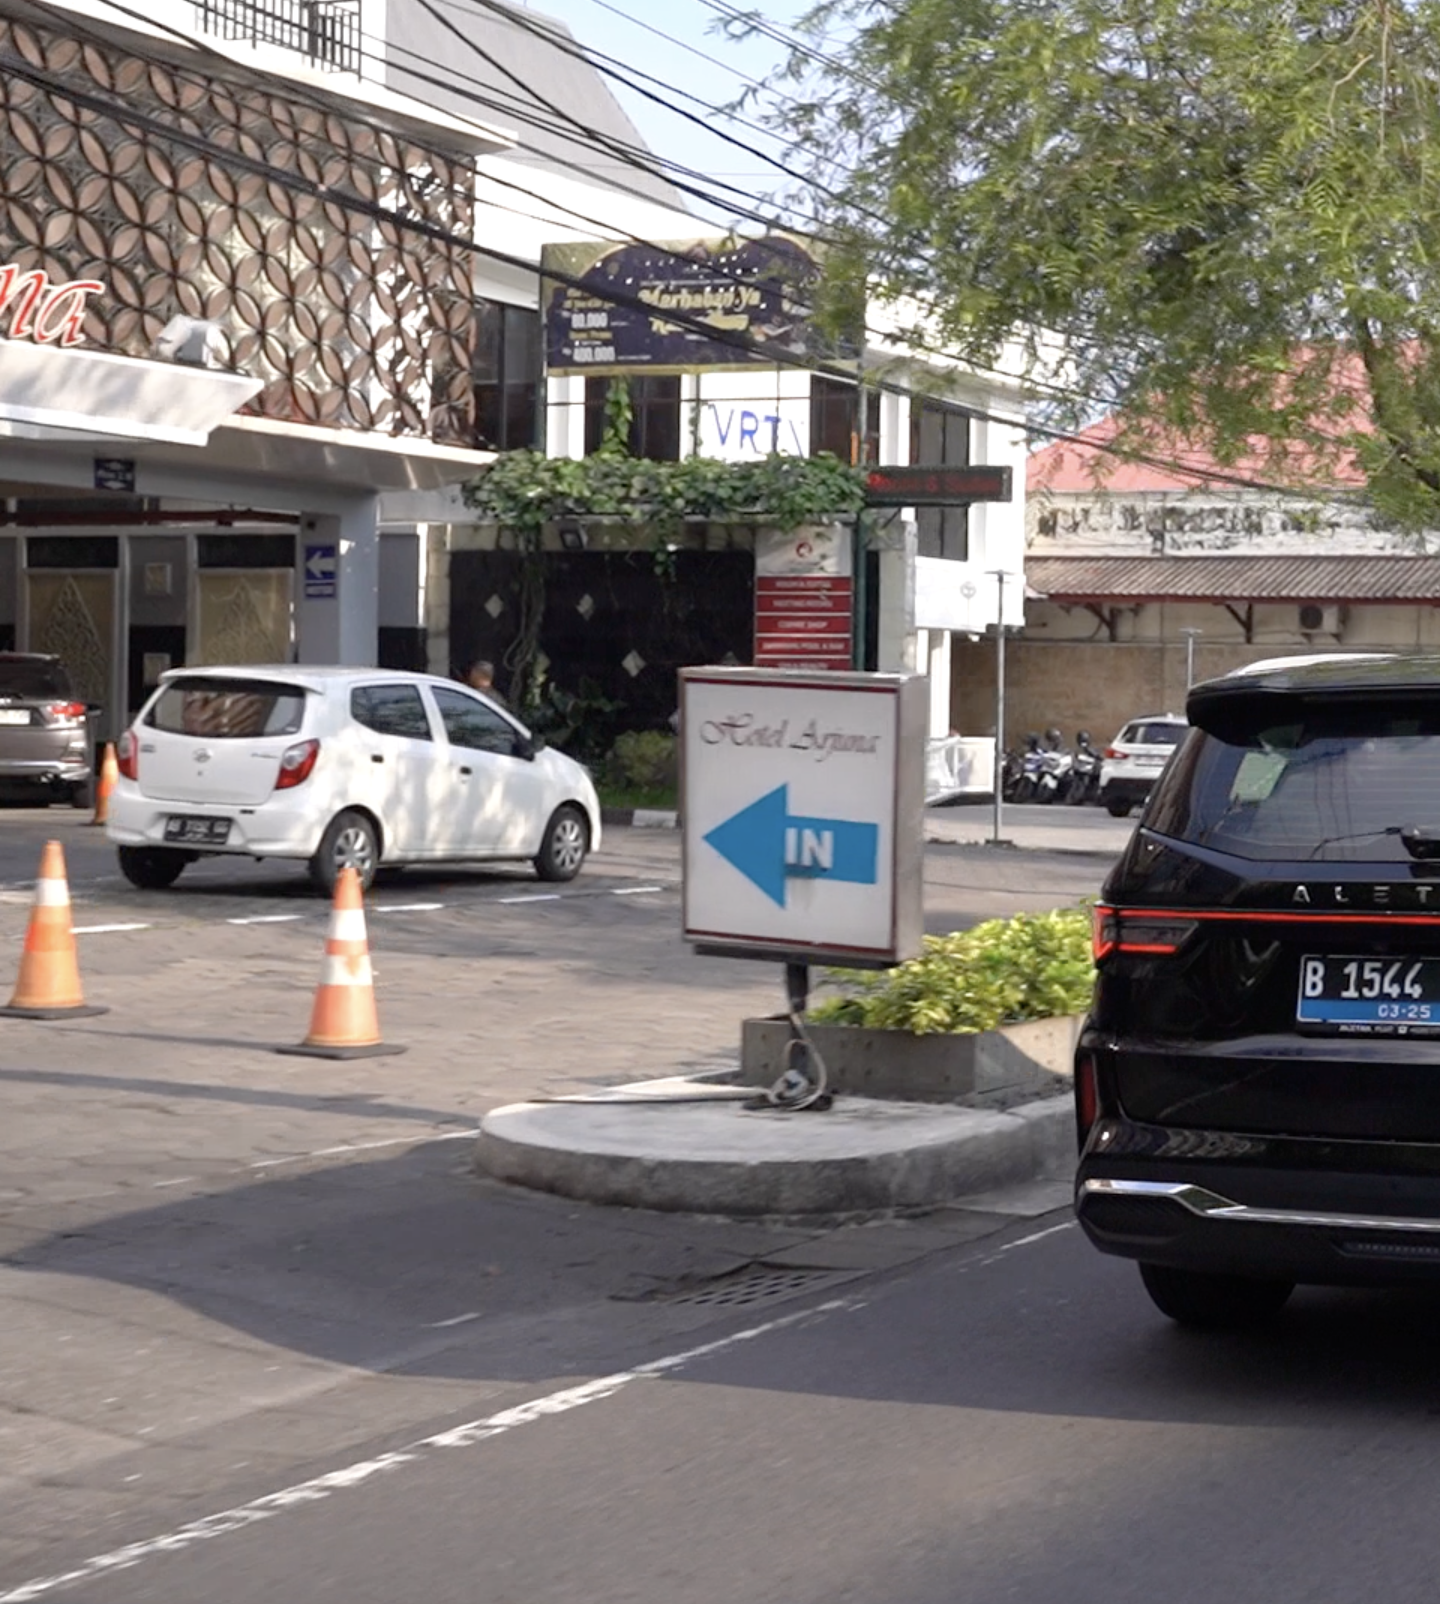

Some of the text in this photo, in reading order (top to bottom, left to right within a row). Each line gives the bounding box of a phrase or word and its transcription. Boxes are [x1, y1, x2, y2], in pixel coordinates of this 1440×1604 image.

[700, 712, 882, 762] Hotel Arjuna
[784, 826, 834, 869] IN
[1304, 960, 1326, 998] B
[1340, 961, 1424, 1000] 1544
[1376, 1003, 1432, 1019] 03-25
